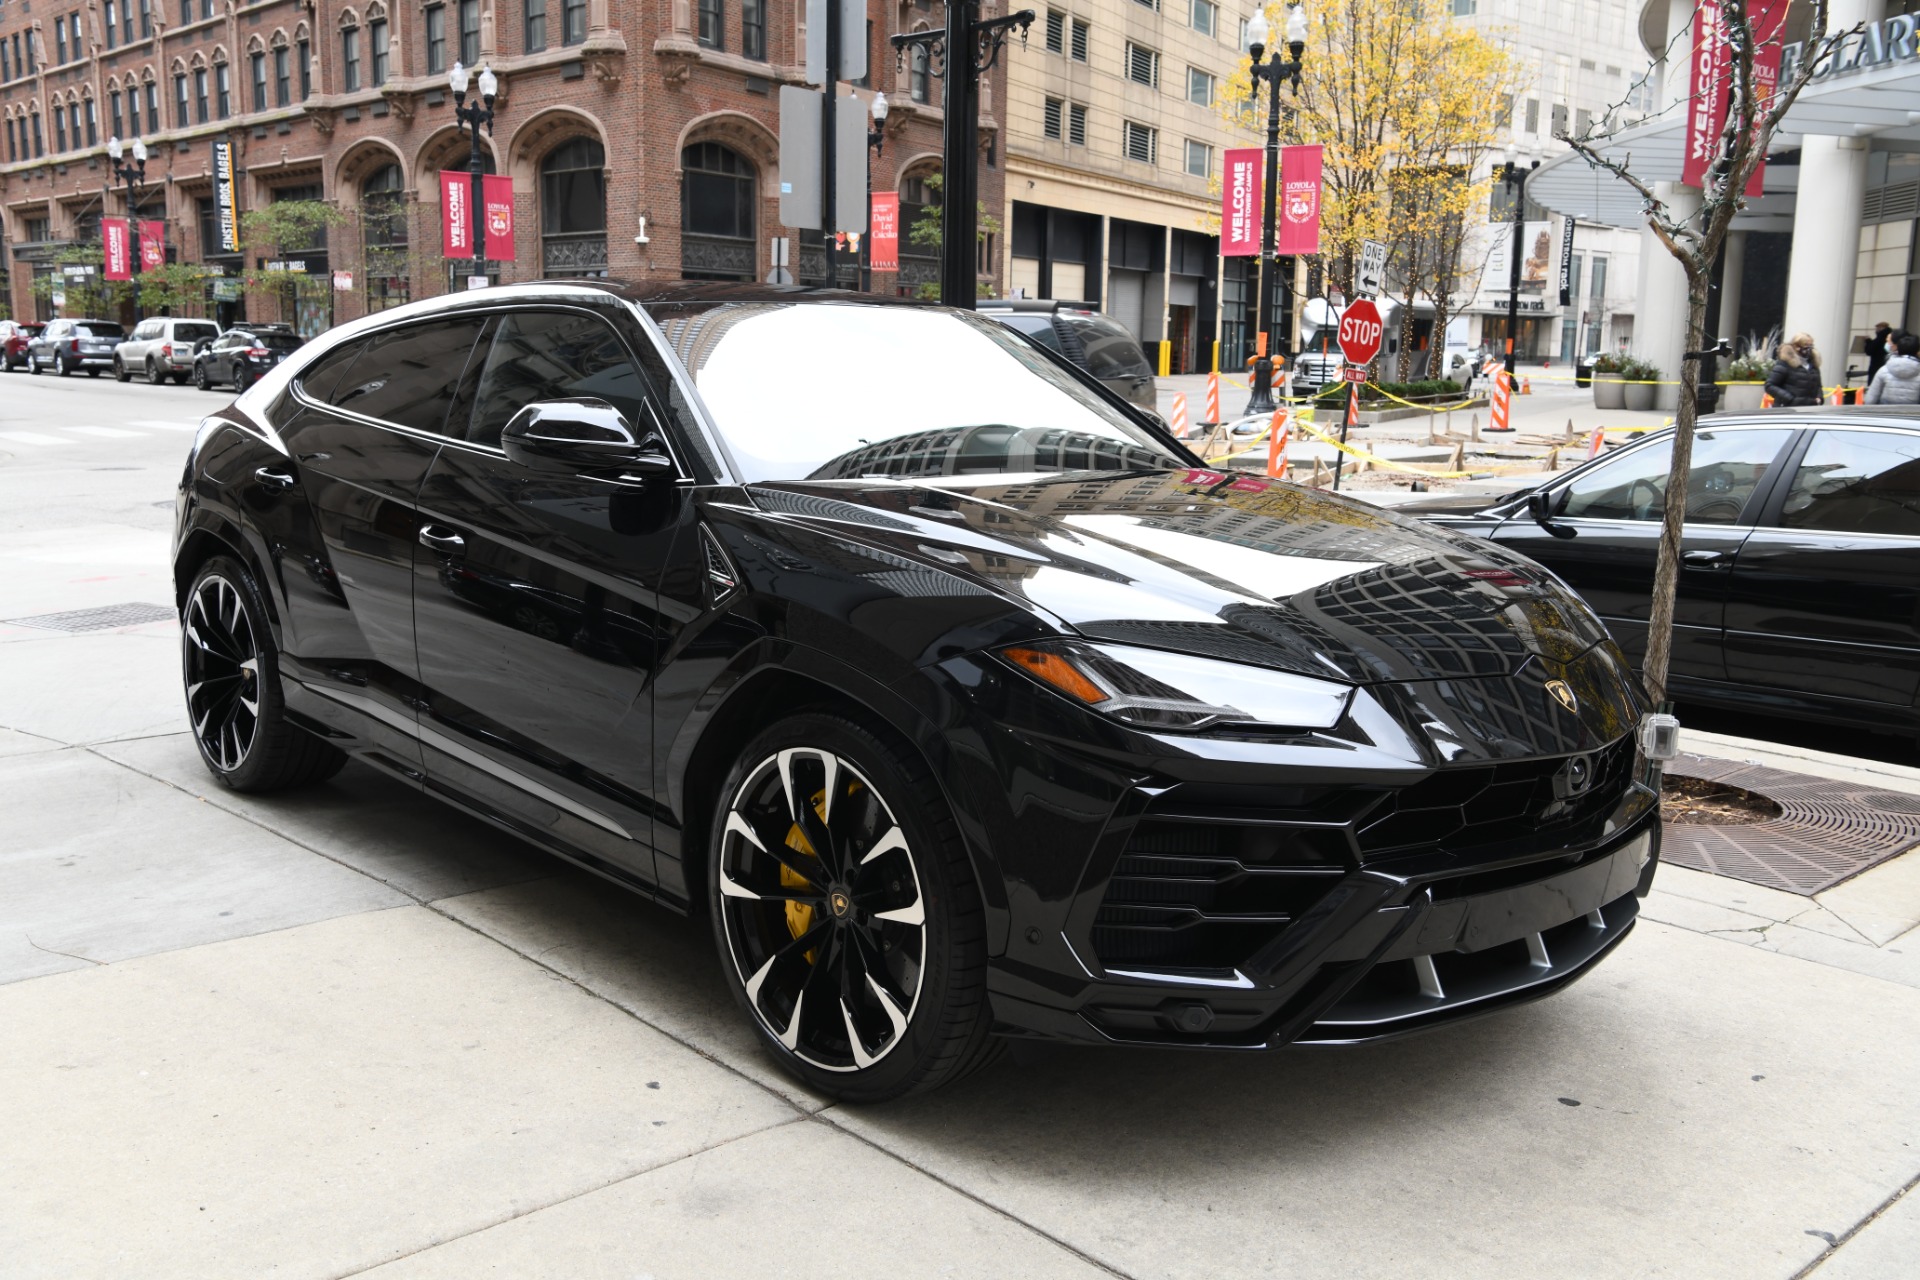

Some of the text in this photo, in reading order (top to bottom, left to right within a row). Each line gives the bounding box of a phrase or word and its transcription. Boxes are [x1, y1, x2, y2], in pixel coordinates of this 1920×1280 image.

[1692, 5, 1715, 160] WELCOME
[1709, 67, 1720, 115] TOWER
[1704, 119, 1715, 162] WATER
[216, 143, 231, 179] BAGELS
[1231, 162, 1246, 243] WELCOME
[1286, 181, 1316, 190] LOYOLA
[220, 208, 234, 250] EINSTEIN
[448, 181, 461, 248] WELCOME
[873, 213, 893, 222] David
[881, 222, 893, 230] Lee
[108, 226, 120, 273] WELCOME
[1366, 244, 1383, 261] ONE
[1560, 216, 1573, 291] ORDSTROM rack
[1363, 261, 1381, 275] WAY
[1341, 317, 1381, 346] STOP
[1347, 370, 1364, 381] ALL WAY
[1328, 438, 1356, 455] CAUTION
